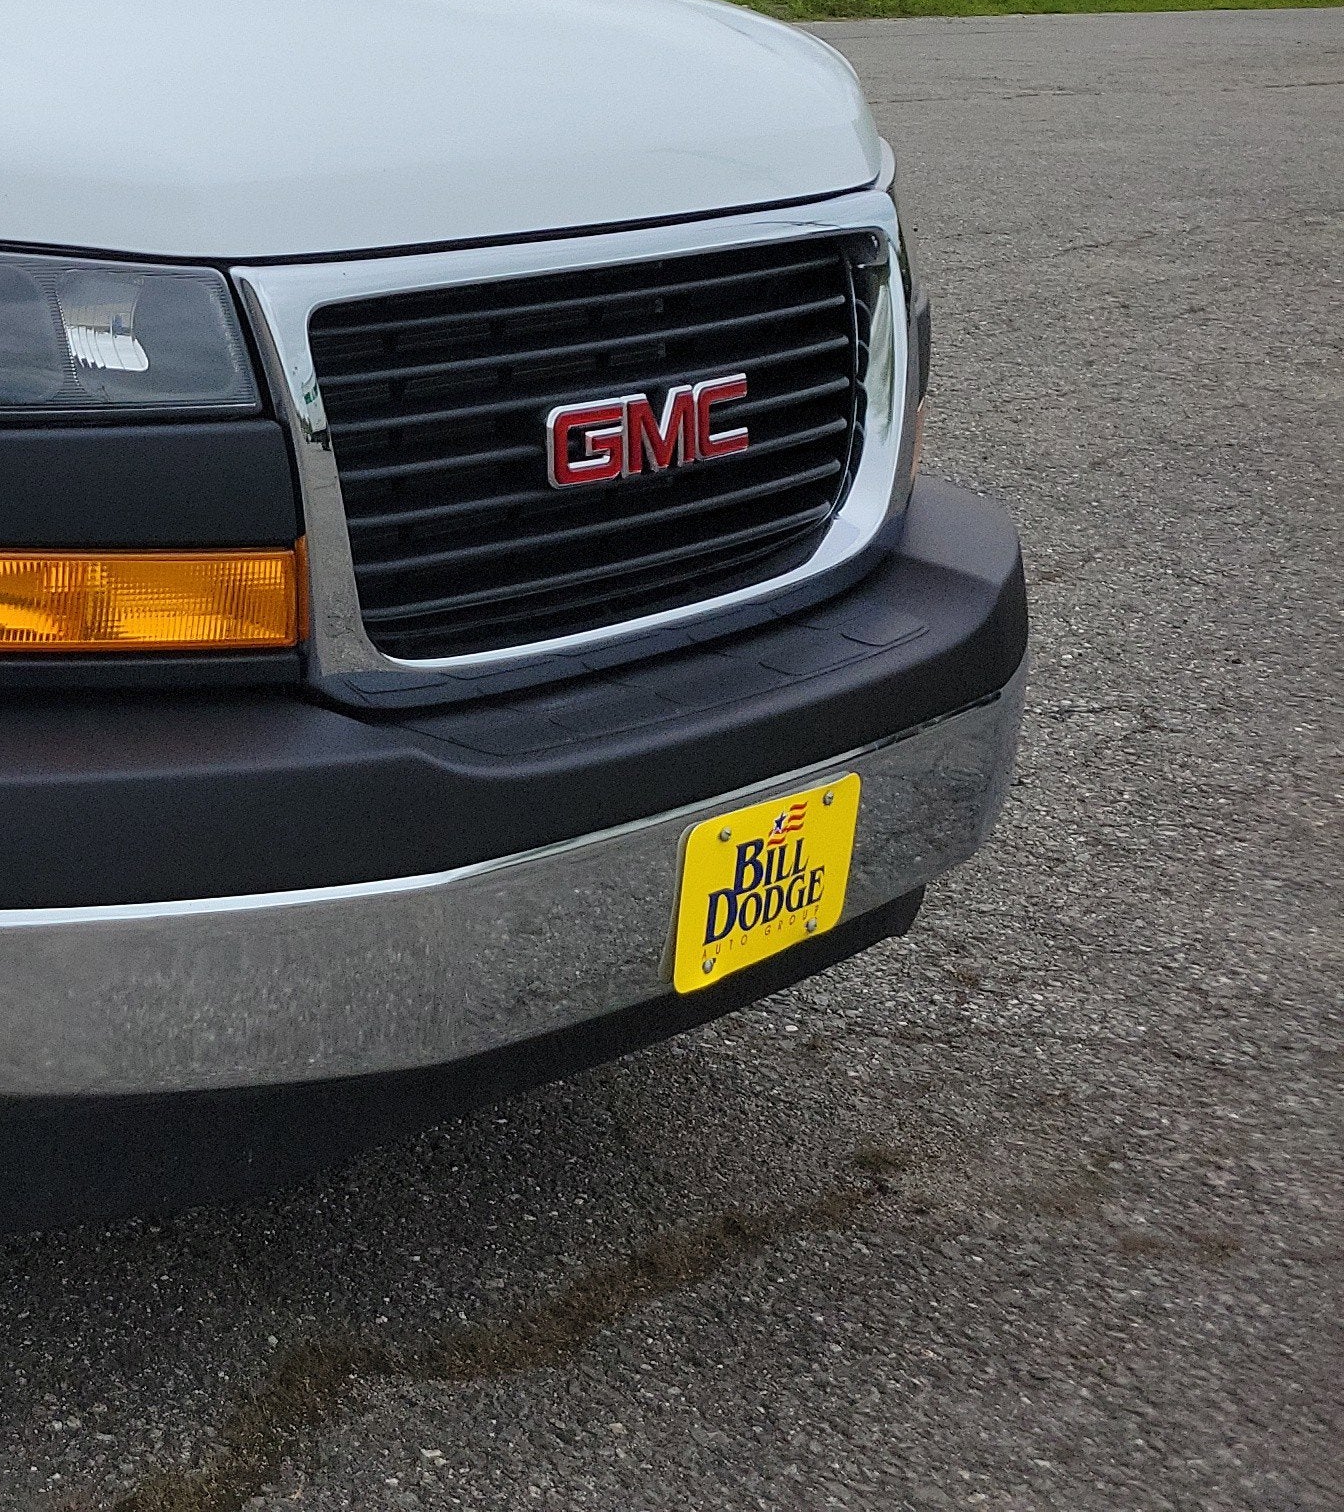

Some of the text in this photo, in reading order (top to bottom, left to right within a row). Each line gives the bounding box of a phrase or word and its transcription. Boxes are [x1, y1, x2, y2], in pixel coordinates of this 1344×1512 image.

[547, 372, 749, 489] GMC
[734, 837, 808, 894] BILL
[701, 904, 820, 960] AUTO GROUP
[703, 865, 825, 946] DODGE
